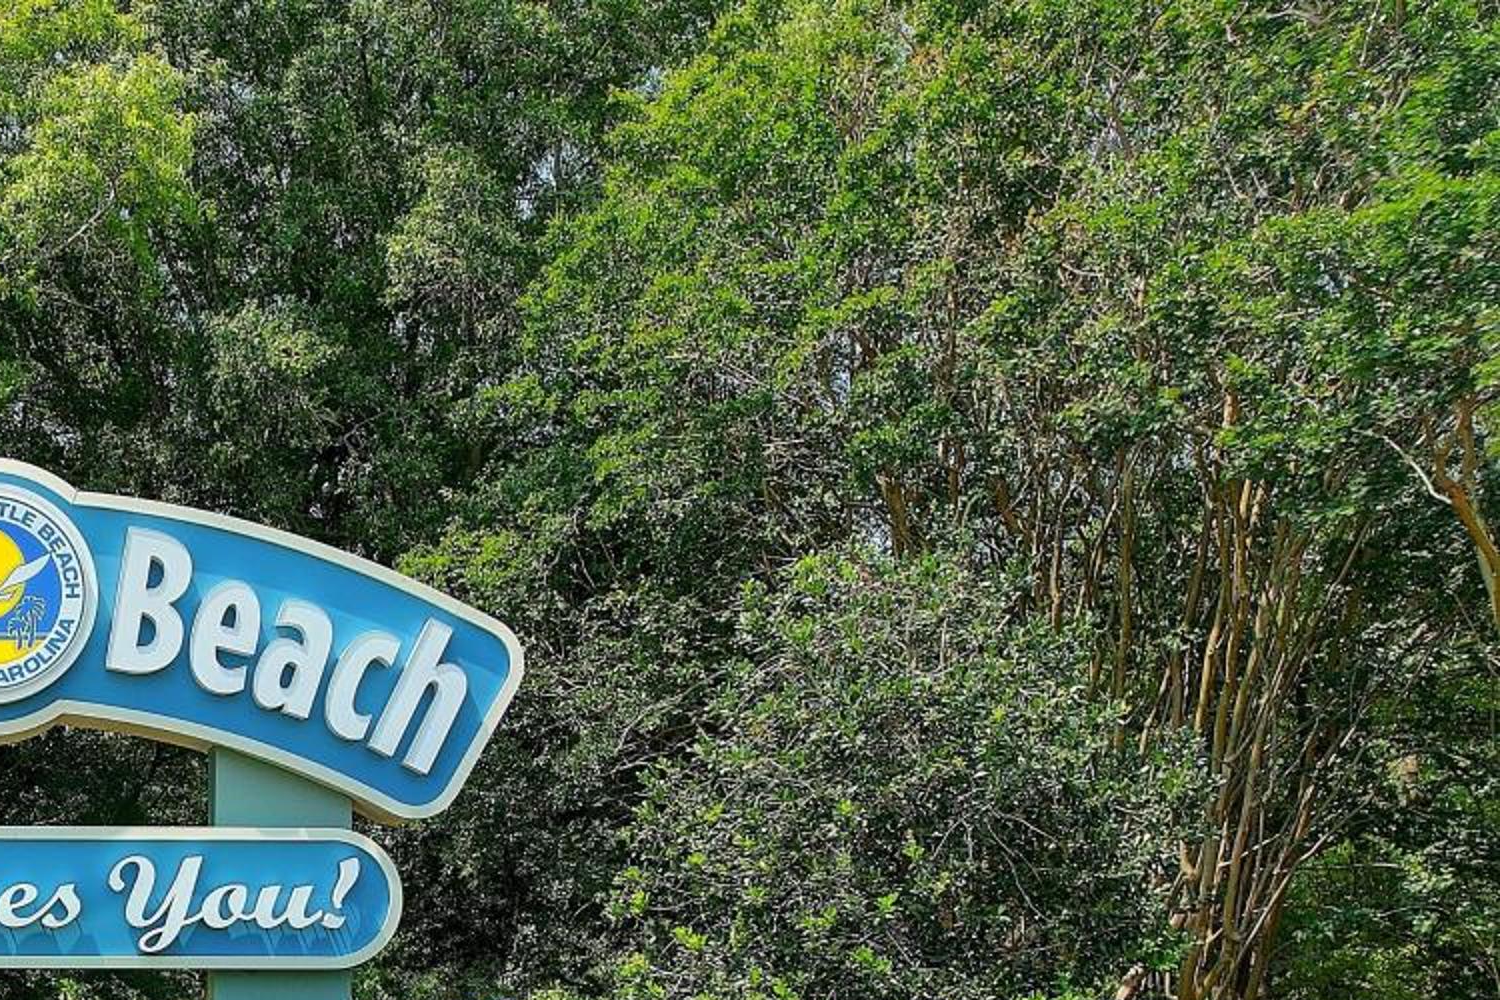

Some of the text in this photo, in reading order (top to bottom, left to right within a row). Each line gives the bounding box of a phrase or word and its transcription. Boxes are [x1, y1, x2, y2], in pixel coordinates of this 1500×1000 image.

[37, 522, 80, 599] BEACH
[105, 526, 472, 778] Beach
[107, 855, 361, 955] You!
